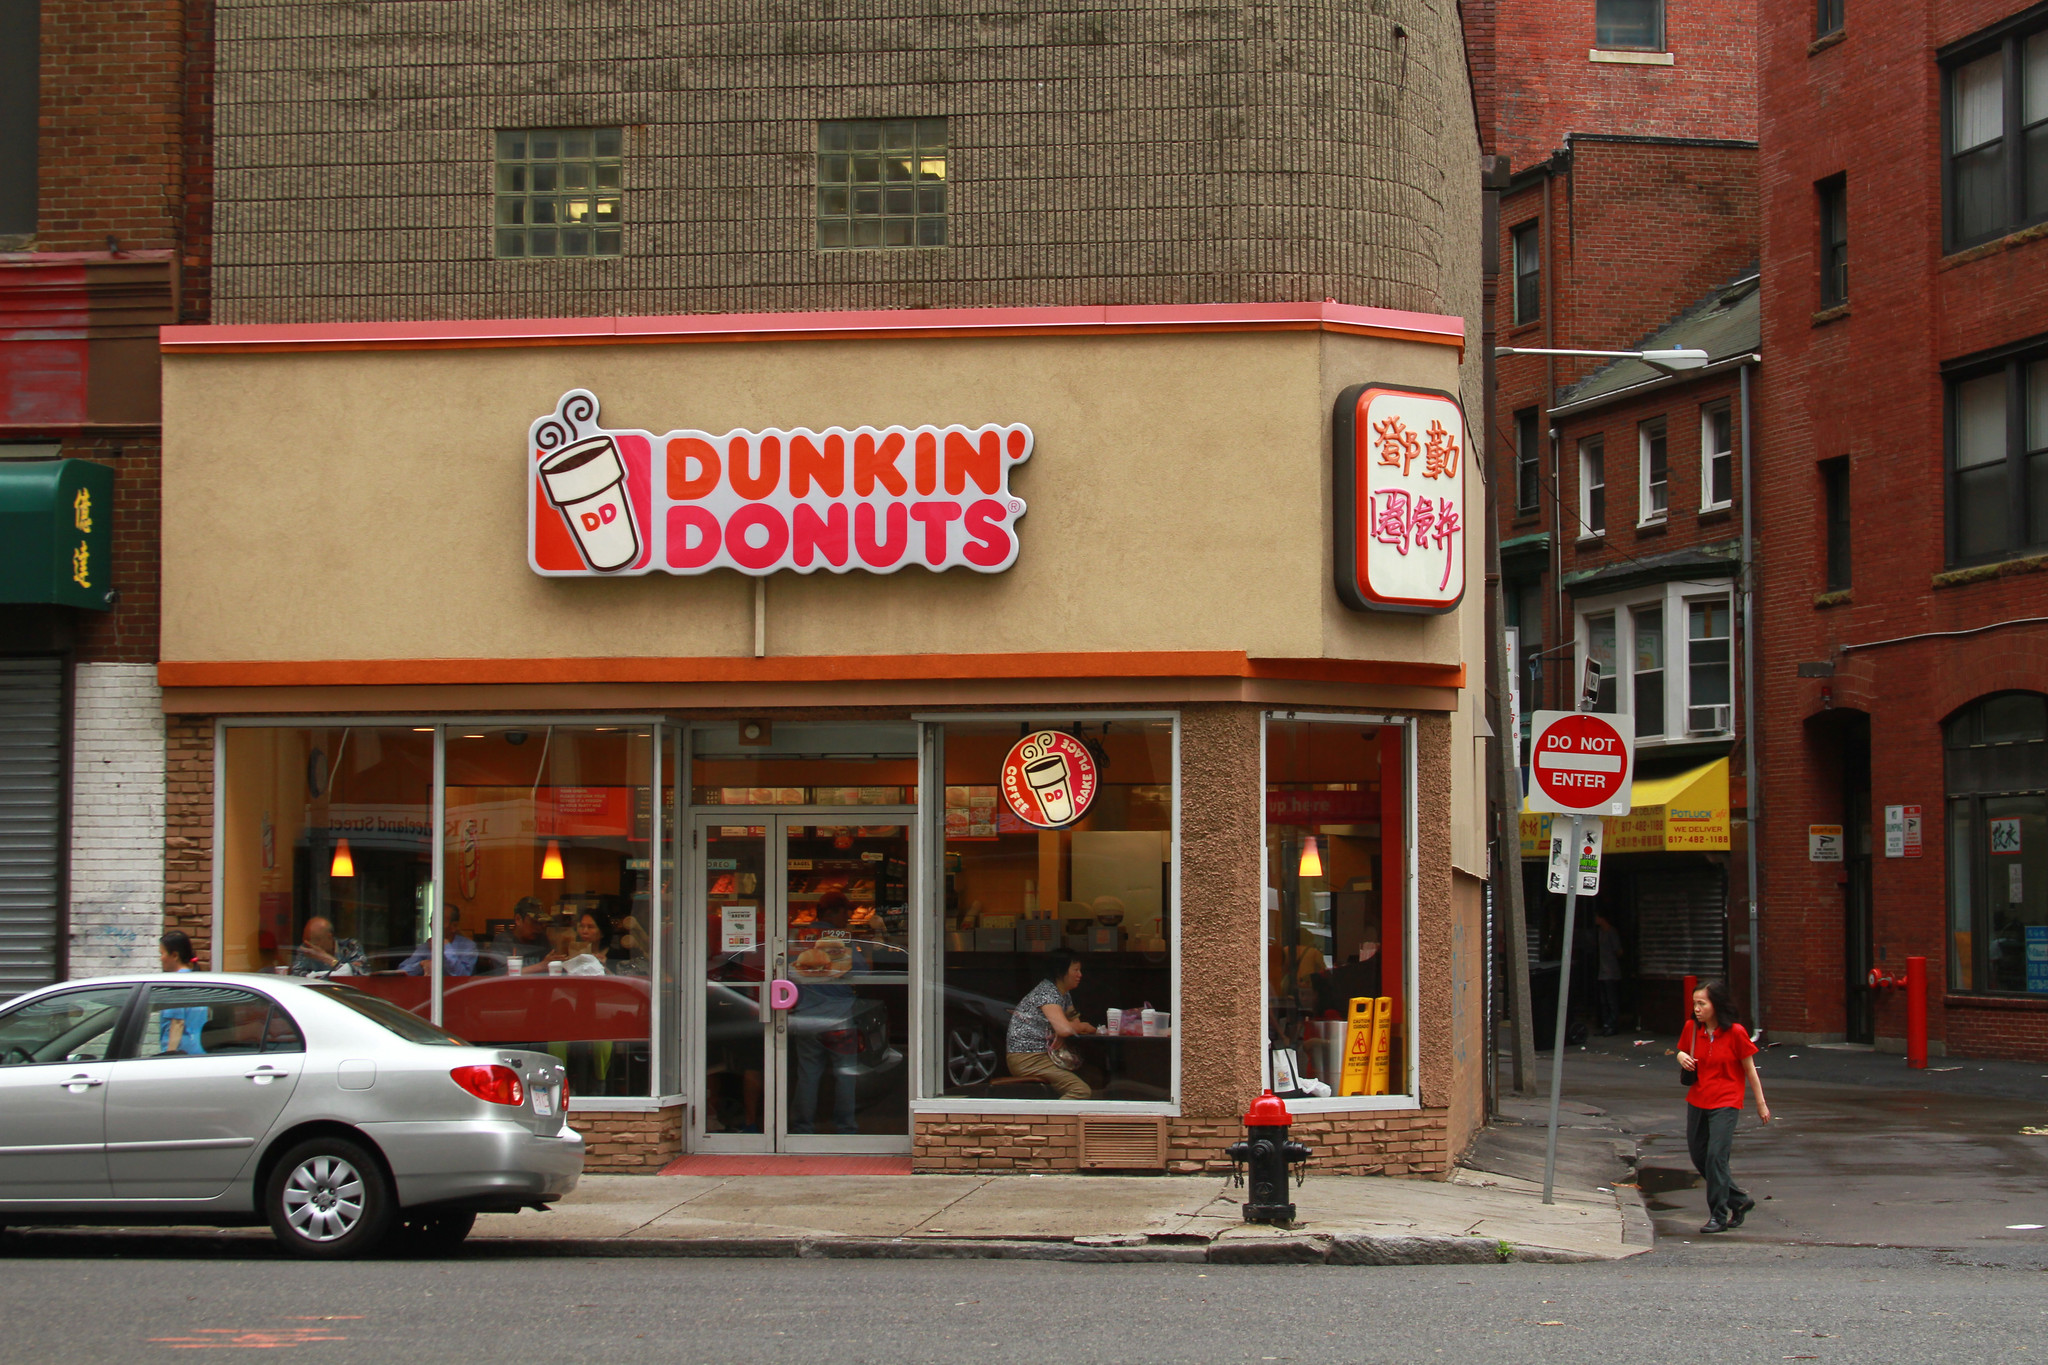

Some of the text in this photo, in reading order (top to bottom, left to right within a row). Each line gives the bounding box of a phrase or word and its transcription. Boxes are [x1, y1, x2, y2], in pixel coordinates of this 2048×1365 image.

[666, 430, 1026, 501] DUNKIN'
[579, 503, 617, 533] DD
[666, 498, 1011, 570] DONUTS
[1547, 735, 1616, 752] DO NOT
[1060, 738, 1093, 805] BAKE PLACE
[1552, 772, 1606, 789] ENTER
[1006, 765, 1030, 814] COFFEE
[1044, 788, 1064, 803] DD
[771, 979, 798, 1010] D
